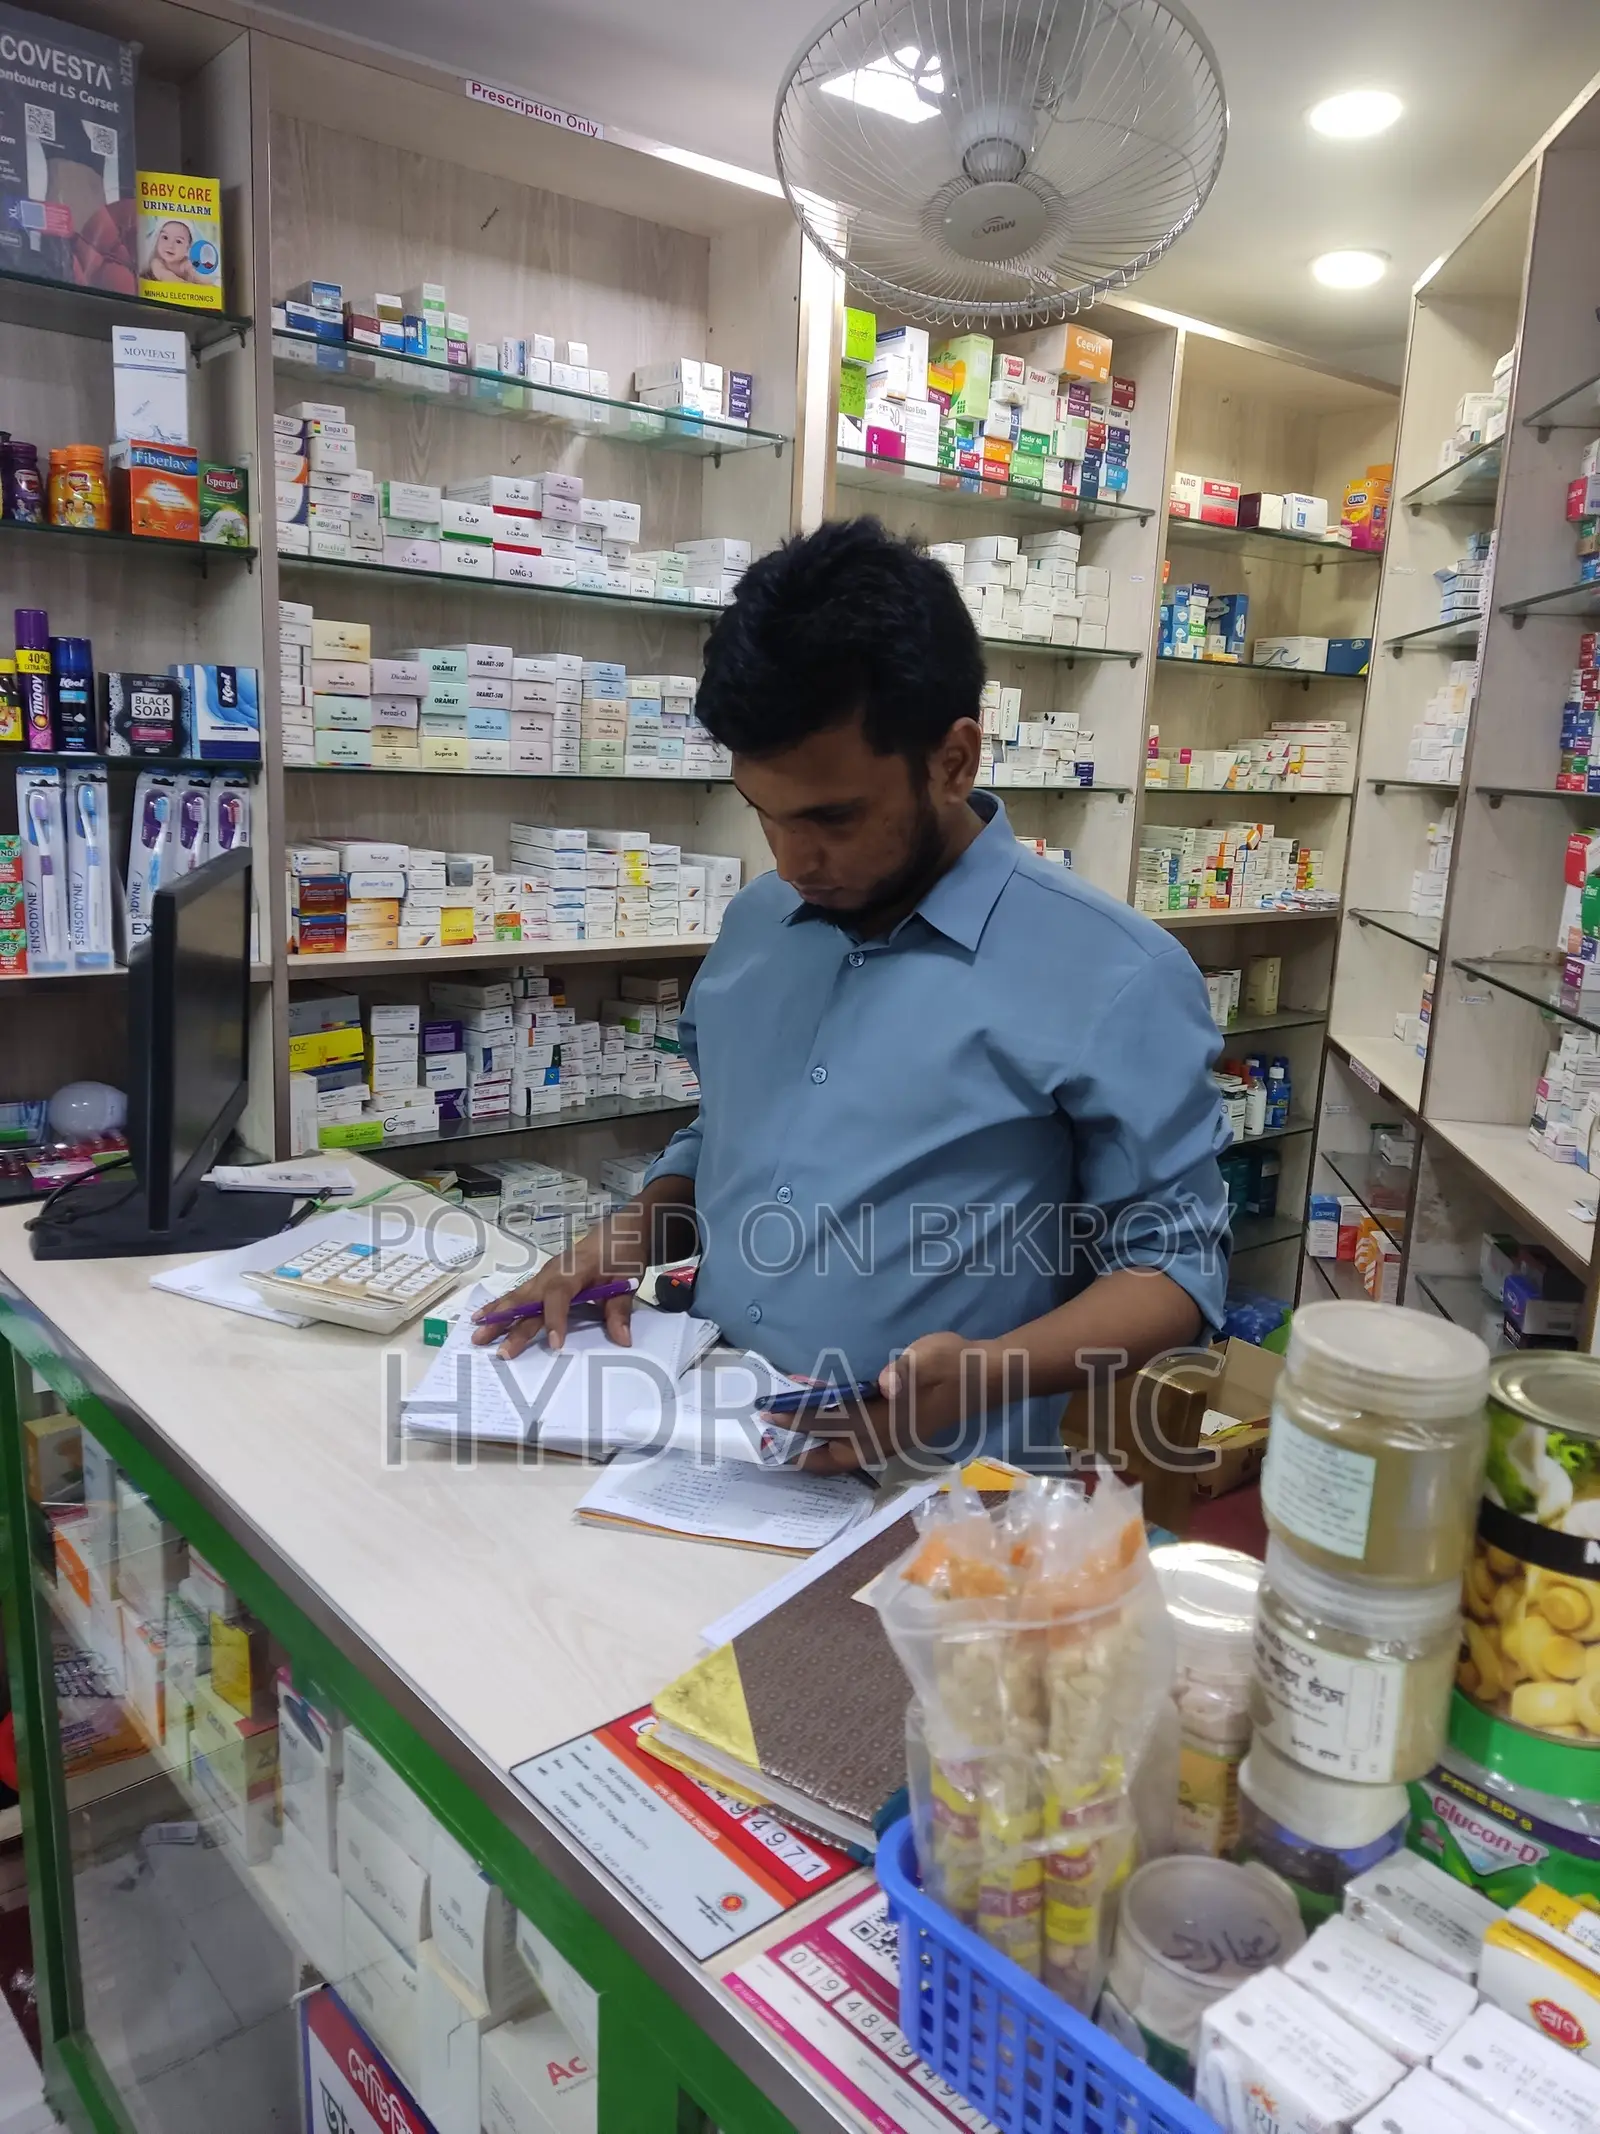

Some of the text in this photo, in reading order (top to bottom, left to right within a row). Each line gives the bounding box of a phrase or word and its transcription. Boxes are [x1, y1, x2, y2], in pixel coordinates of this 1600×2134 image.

[1, 35, 112, 91] COVESTA
[0, 68, 57, 94] ontoured
[79, 90, 120, 113] Corset
[471, 82, 599, 138] Prescription Only
[141, 182, 213, 202] BABY CARE
[143, 201, 212, 216] URINE ALARM
[144, 289, 214, 302] MINHAJ ELECTRONICS
[1076, 336, 1102, 355] Ceevit
[123, 347, 177, 361] MOVIFAST
[1029, 372, 1047, 384] Flugal
[1011, 415, 1019, 425] 75
[1108, 409, 1123, 419] Flugal
[135, 450, 189, 471] Fiberlax
[206, 473, 239, 490] Ispergul
[1180, 476, 1197, 488] NRG
[458, 515, 480, 524] E-CAP
[456, 555, 479, 565] E-CAP
[509, 568, 533, 579] OMG-3
[432, 664, 457, 673] ORAMET
[60, 678, 85, 688] Kool
[221, 672, 233, 704] Kool
[135, 695, 170, 707] BLACK
[434, 697, 459, 706] ORAMET
[134, 705, 171, 718] SOAP
[74, 883, 85, 947] SENSODYNE
[28, 892, 41, 955] SENSODYNE
[1433, 1795, 1541, 1866] Glucon-D
[750, 1819, 823, 1877] 4971
[790, 1951, 840, 1992] 019
